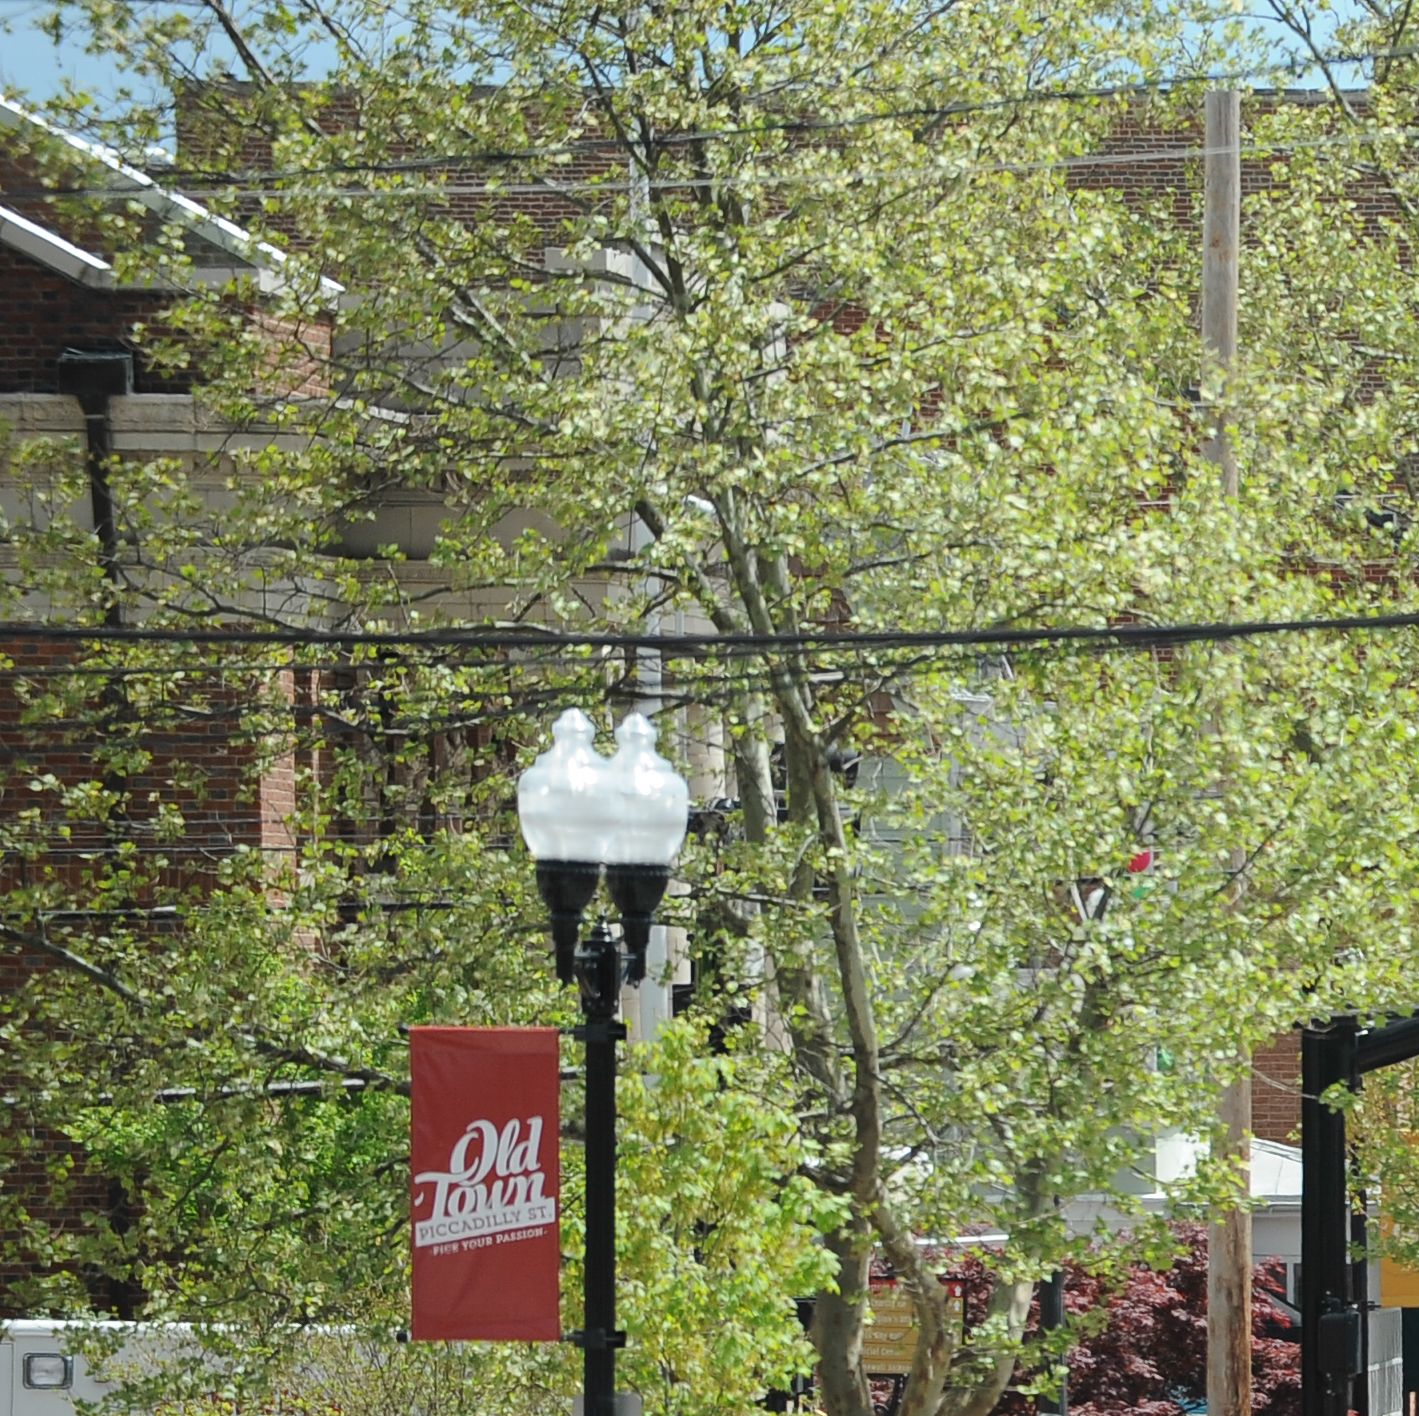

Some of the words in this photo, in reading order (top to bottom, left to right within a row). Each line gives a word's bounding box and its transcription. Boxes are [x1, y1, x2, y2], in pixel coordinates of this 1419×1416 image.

[450, 1115, 544, 1185] Old
[414, 1171, 546, 1221] Town
[419, 1210, 522, 1241] PICCADILLY
[462, 1236, 493, 1251] YOUR
